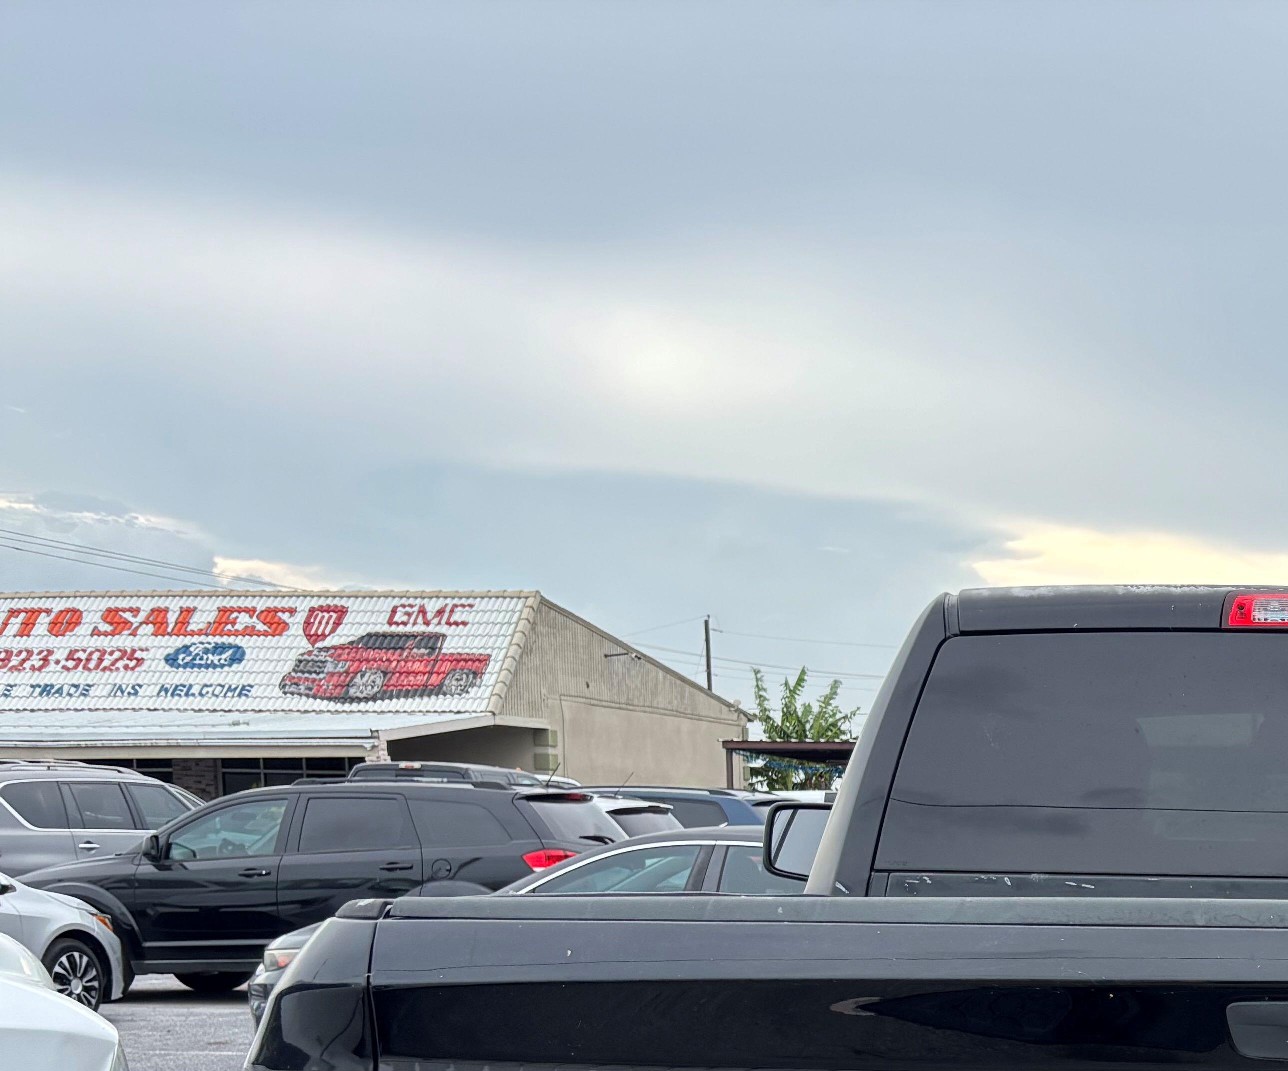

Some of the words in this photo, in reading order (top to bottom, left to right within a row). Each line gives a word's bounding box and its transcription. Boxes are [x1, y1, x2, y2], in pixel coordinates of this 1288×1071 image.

[90, 606, 297, 637] SALES
[387, 603, 475, 627] GMC
[175, 643, 238, 666] Ford
[28, 683, 93, 698] TRADE
[108, 683, 144, 698] INS
[157, 683, 254, 698] WELCOME
